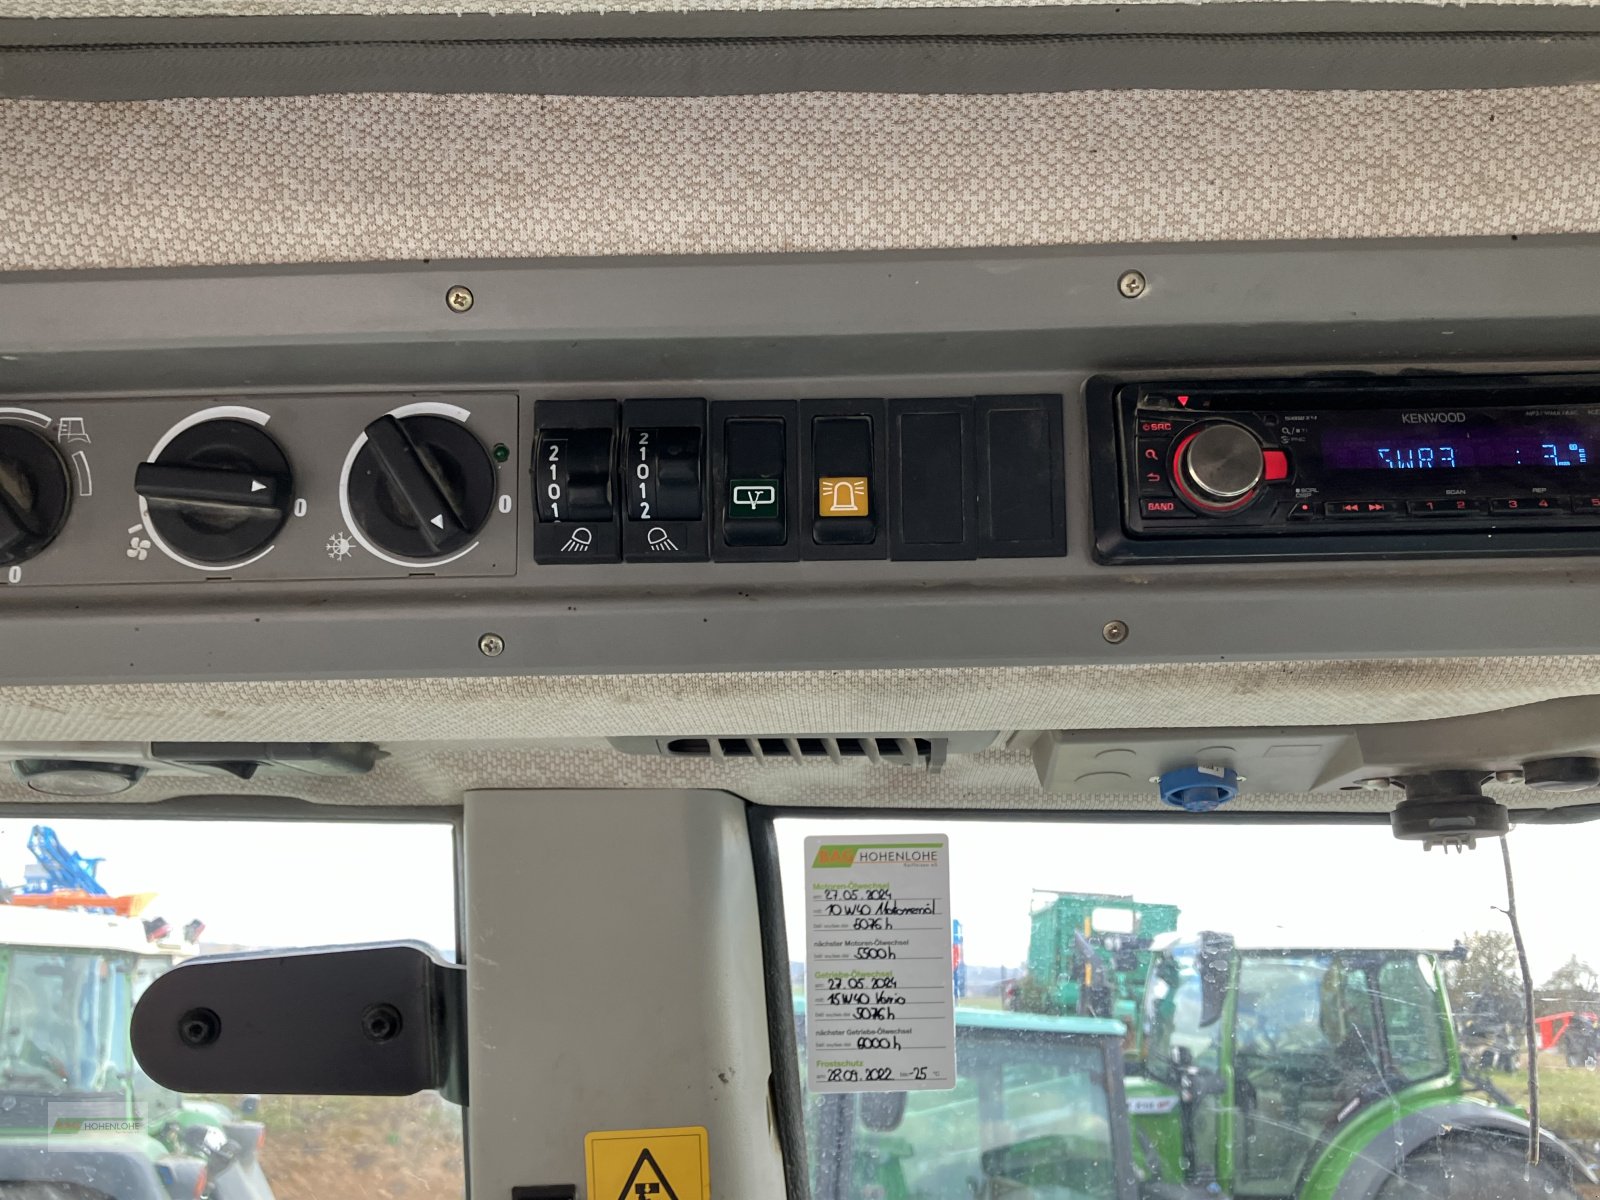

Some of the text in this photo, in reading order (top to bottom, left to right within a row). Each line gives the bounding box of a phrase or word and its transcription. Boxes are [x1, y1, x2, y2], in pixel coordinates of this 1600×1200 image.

[1402, 412, 1466, 424] KENWOOD
[1151, 422, 1172, 431] SRC
[638, 432, 649, 445] 2
[549, 445, 559, 461] 2
[639, 446, 646, 461] 1
[550, 464, 557, 481] 1
[636, 463, 649, 480] 0
[548, 483, 561, 500] 0
[639, 482, 646, 499] 1
[551, 502, 559, 518] 1
[640, 502, 651, 519] 2
[1148, 502, 1174, 511] BAND
[1426, 501, 1465, 510] 1 2
[1508, 500, 1548, 508] 3 4
[819, 848, 938, 864] BAG HOHENLOHE
